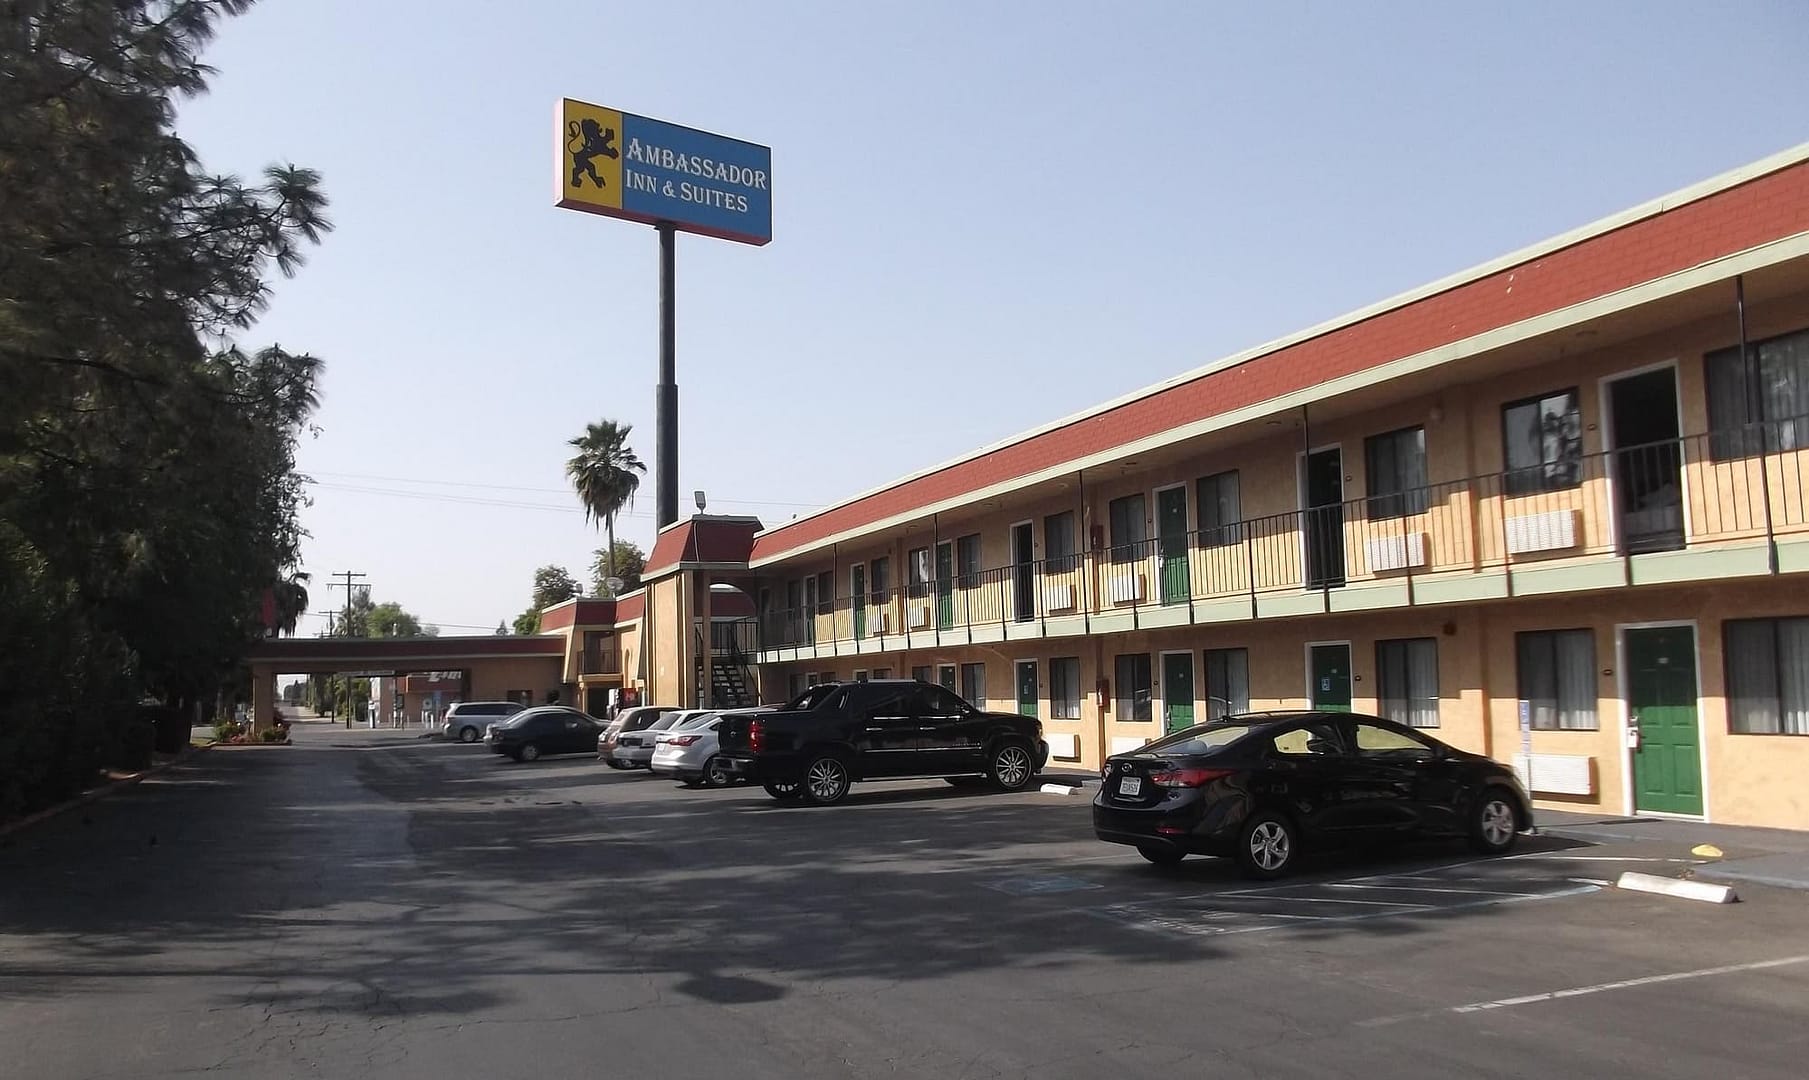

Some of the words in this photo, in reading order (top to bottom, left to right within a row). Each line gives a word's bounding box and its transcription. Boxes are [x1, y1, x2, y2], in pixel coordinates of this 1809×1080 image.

[626, 137, 767, 190] AMBASSADOR
[625, 169, 657, 195] INN
[662, 180, 677, 199] &
[680, 182, 749, 213] SUITES
